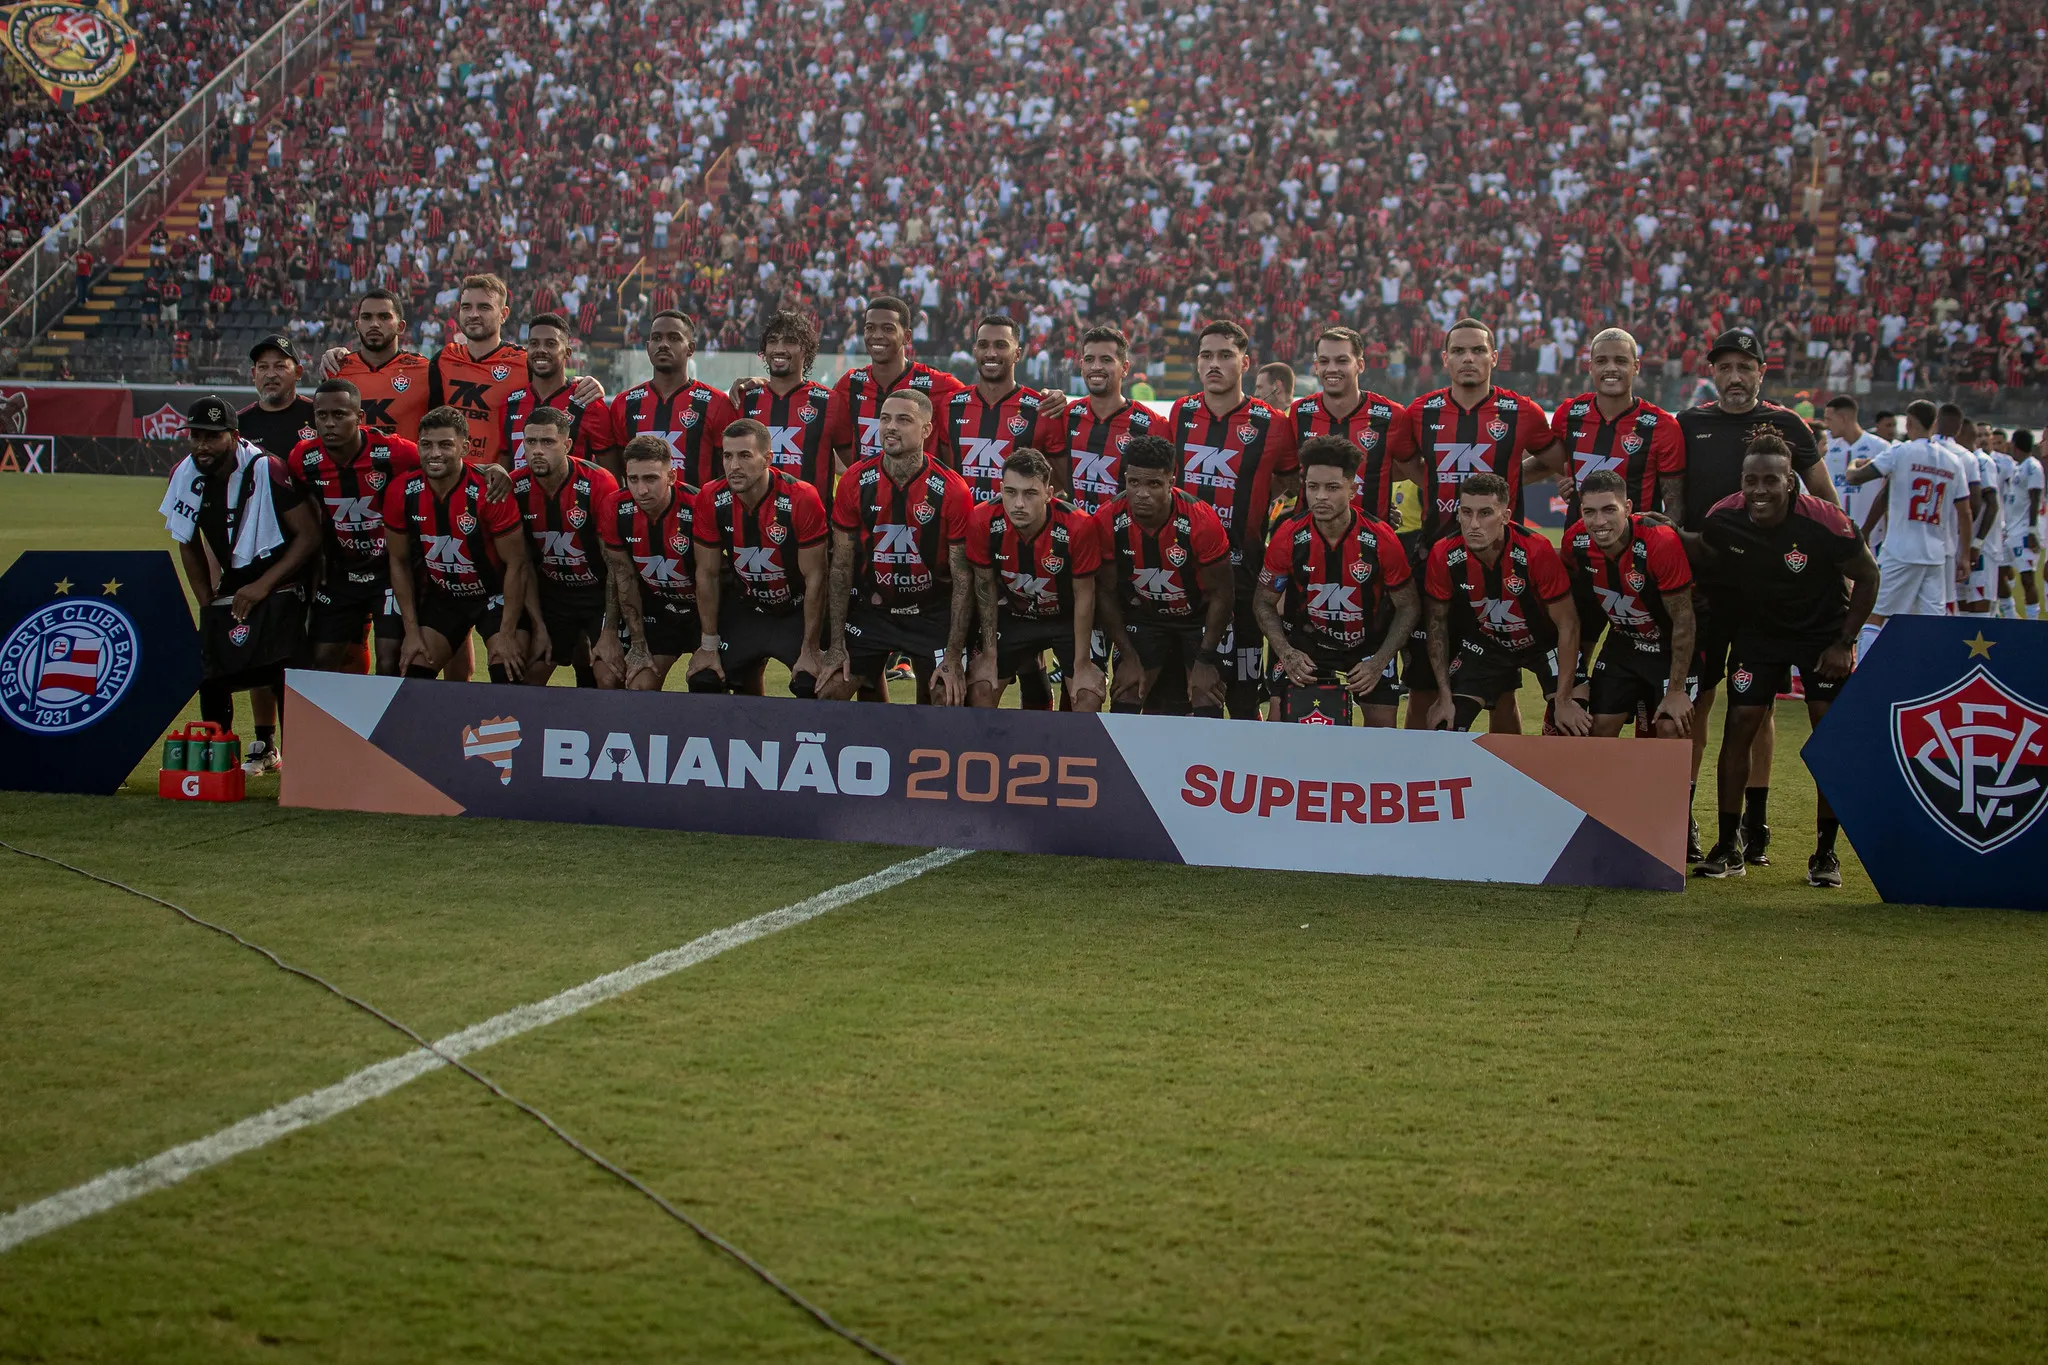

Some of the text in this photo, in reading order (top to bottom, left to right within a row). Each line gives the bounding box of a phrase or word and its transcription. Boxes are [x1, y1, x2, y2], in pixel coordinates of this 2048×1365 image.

[448, 379, 492, 411] 7K
[959, 437, 1010, 468] 7K
[1071, 449, 1119, 485] 7K
[1184, 443, 1239, 479] 7K
[1434, 443, 1494, 472] 7K
[323, 495, 383, 522] 7K
[1908, 478, 1946, 525] 21
[420, 534, 475, 564] 7K
[532, 530, 586, 557] 7K
[872, 524, 920, 554] 7K
[633, 555, 690, 581] 7K
[733, 546, 786, 572] 7K
[893, 570, 932, 586] fatal
[1132, 568, 1185, 593] 7K
[1307, 583, 1363, 611] 7K
[1470, 597, 1526, 624] 7K
[1593, 586, 1650, 617] 7K
[1328, 627, 1365, 641] fatal
[2, 607, 130, 700] ESPORTE CLUBE BAHIA
[35, 709, 70, 725] 1931
[542, 728, 1098, 808] BAIANÃO 2025
[1180, 764, 1472, 824] SUPERBET
